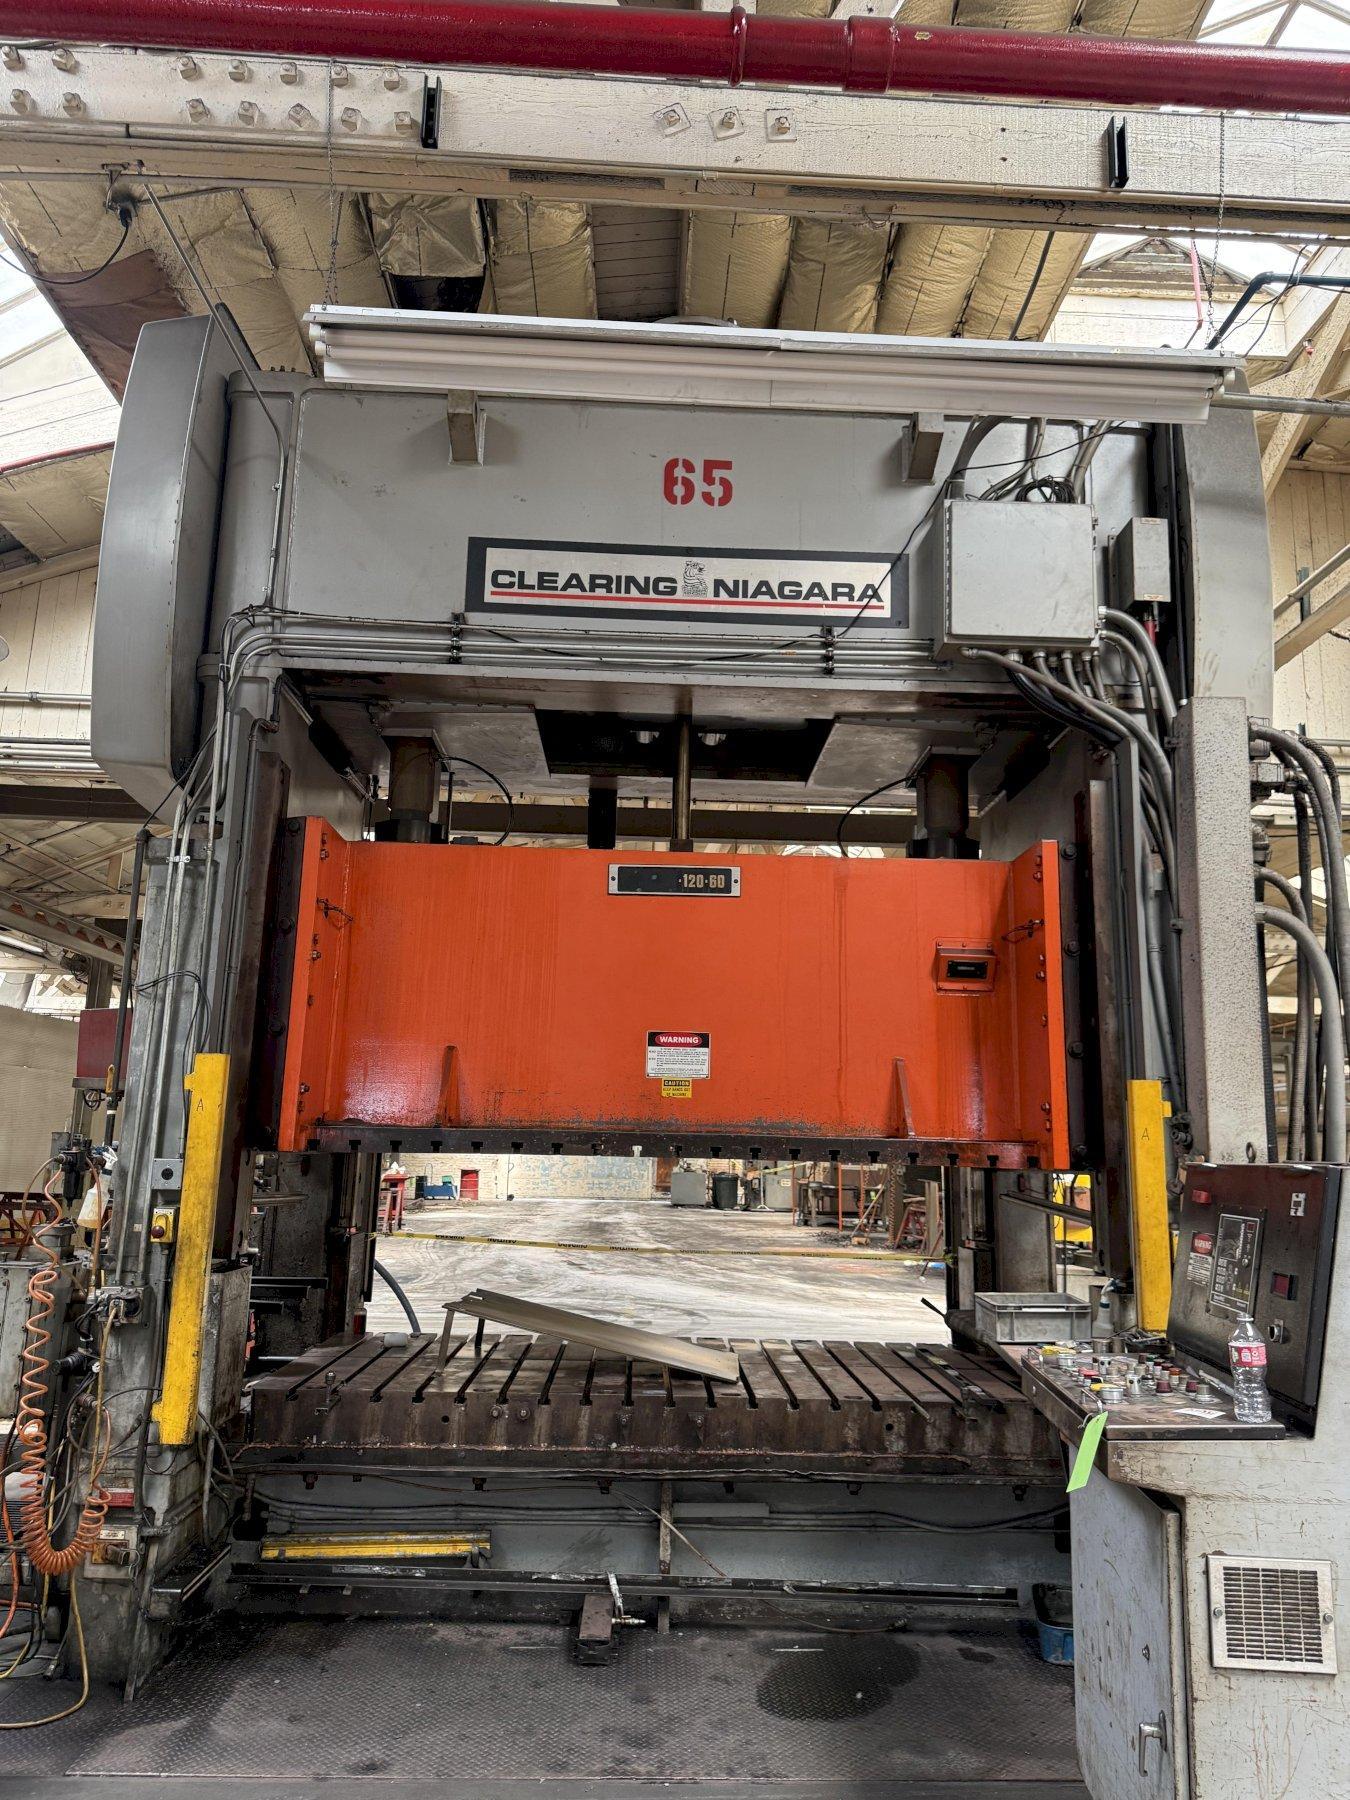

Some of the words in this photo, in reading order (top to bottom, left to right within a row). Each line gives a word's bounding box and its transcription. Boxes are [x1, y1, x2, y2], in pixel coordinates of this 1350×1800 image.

[663, 457, 733, 507] 65
[490, 569, 677, 596] CLEARING
[713, 578, 885, 603] NIAGARA
